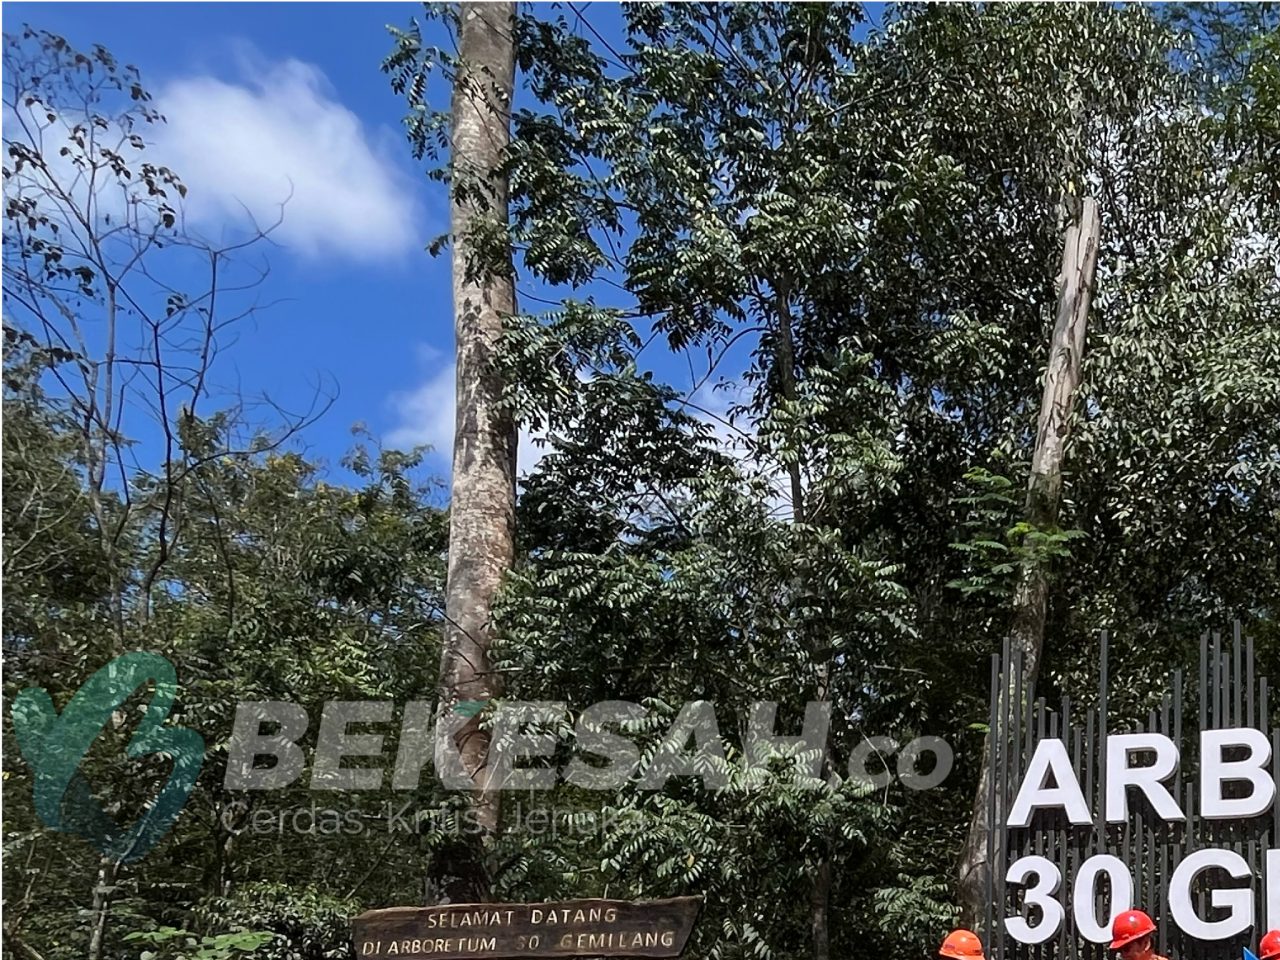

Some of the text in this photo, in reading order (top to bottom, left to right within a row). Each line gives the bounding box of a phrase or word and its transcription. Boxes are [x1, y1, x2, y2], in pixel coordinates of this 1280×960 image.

[1004, 853, 1134, 945] 30
[427, 908, 618, 929] SELAMAT DATANG
[362, 931, 675, 956] DI ARBORETUM 30 GEMILANG
